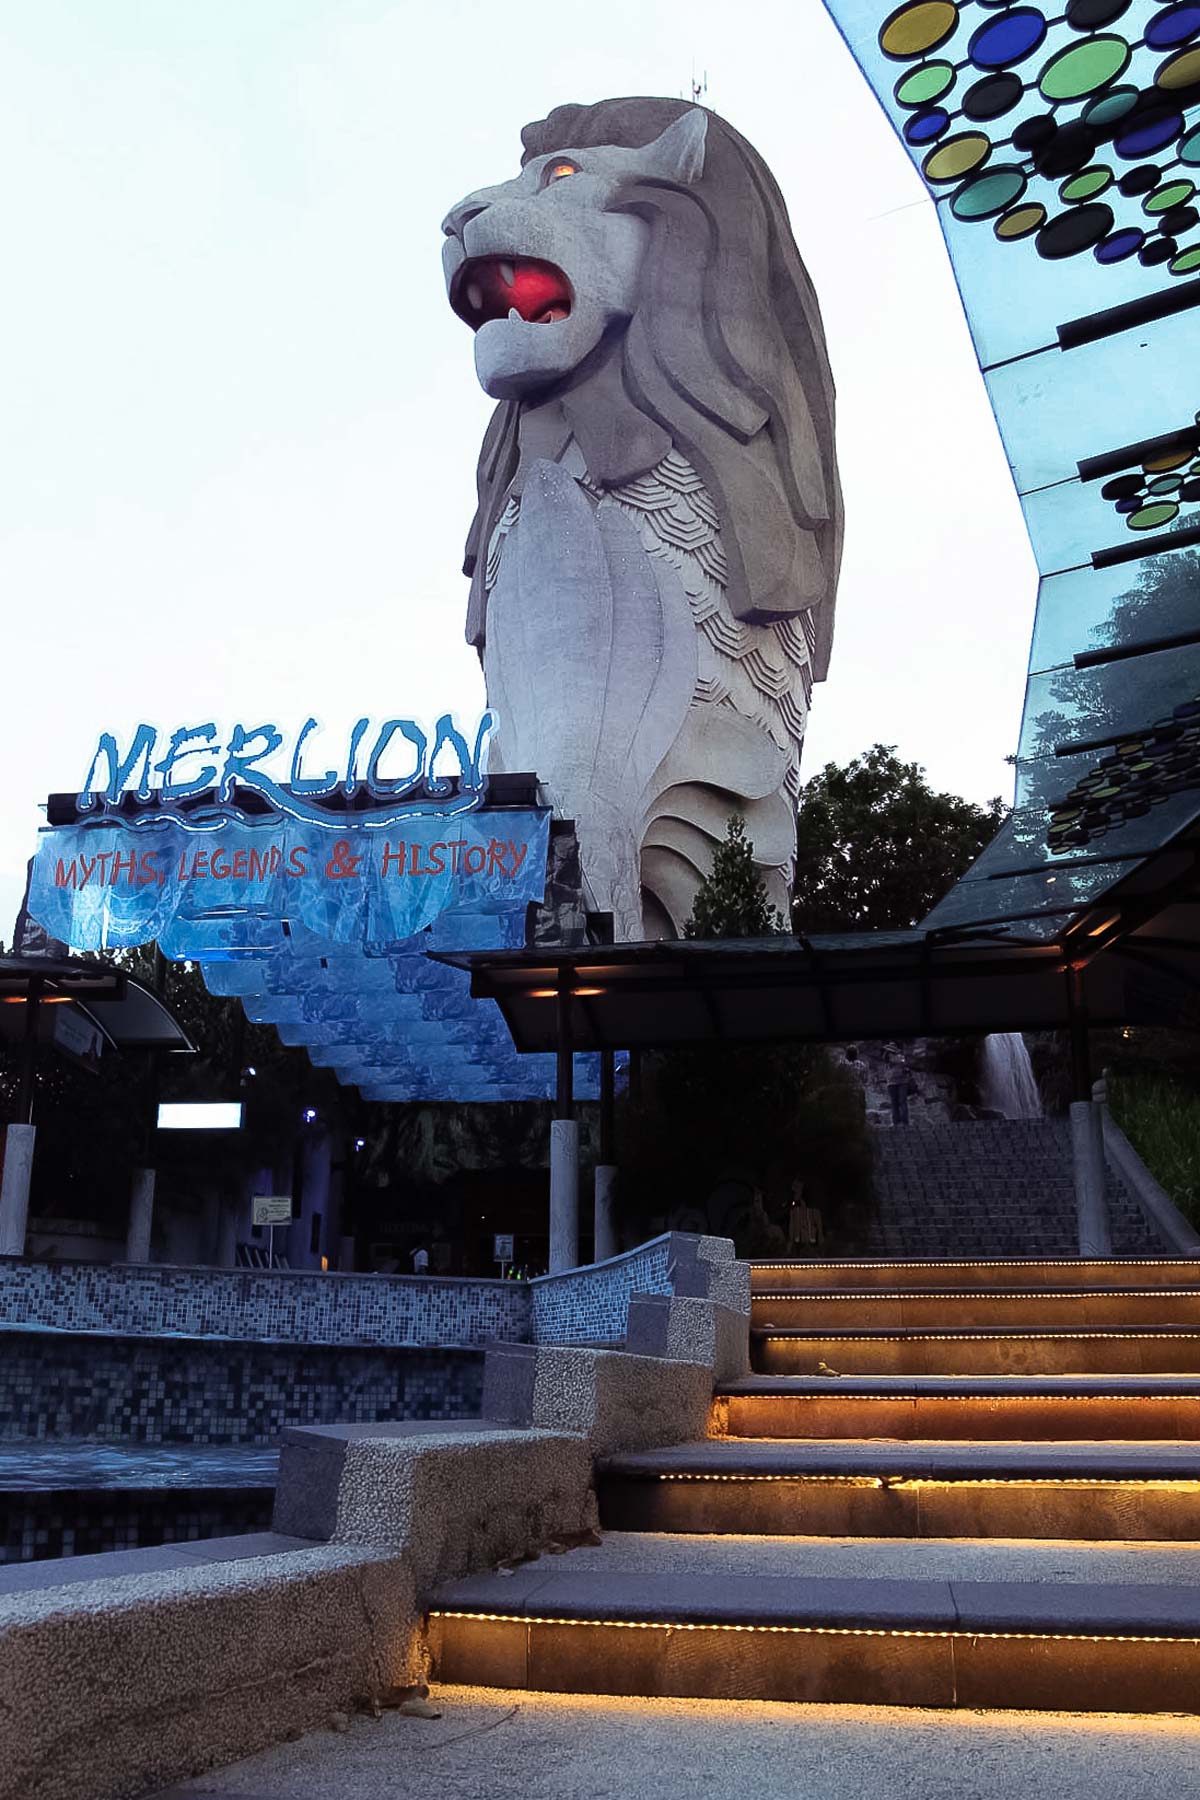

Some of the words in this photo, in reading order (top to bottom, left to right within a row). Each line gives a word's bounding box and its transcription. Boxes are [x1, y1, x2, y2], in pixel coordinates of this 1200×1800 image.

[79, 710, 499, 816] MERLION
[54, 848, 165, 891] MYTHS,
[177, 845, 308, 882] LEGENDS
[325, 840, 363, 879] &
[381, 837, 528, 878] HISTORY
